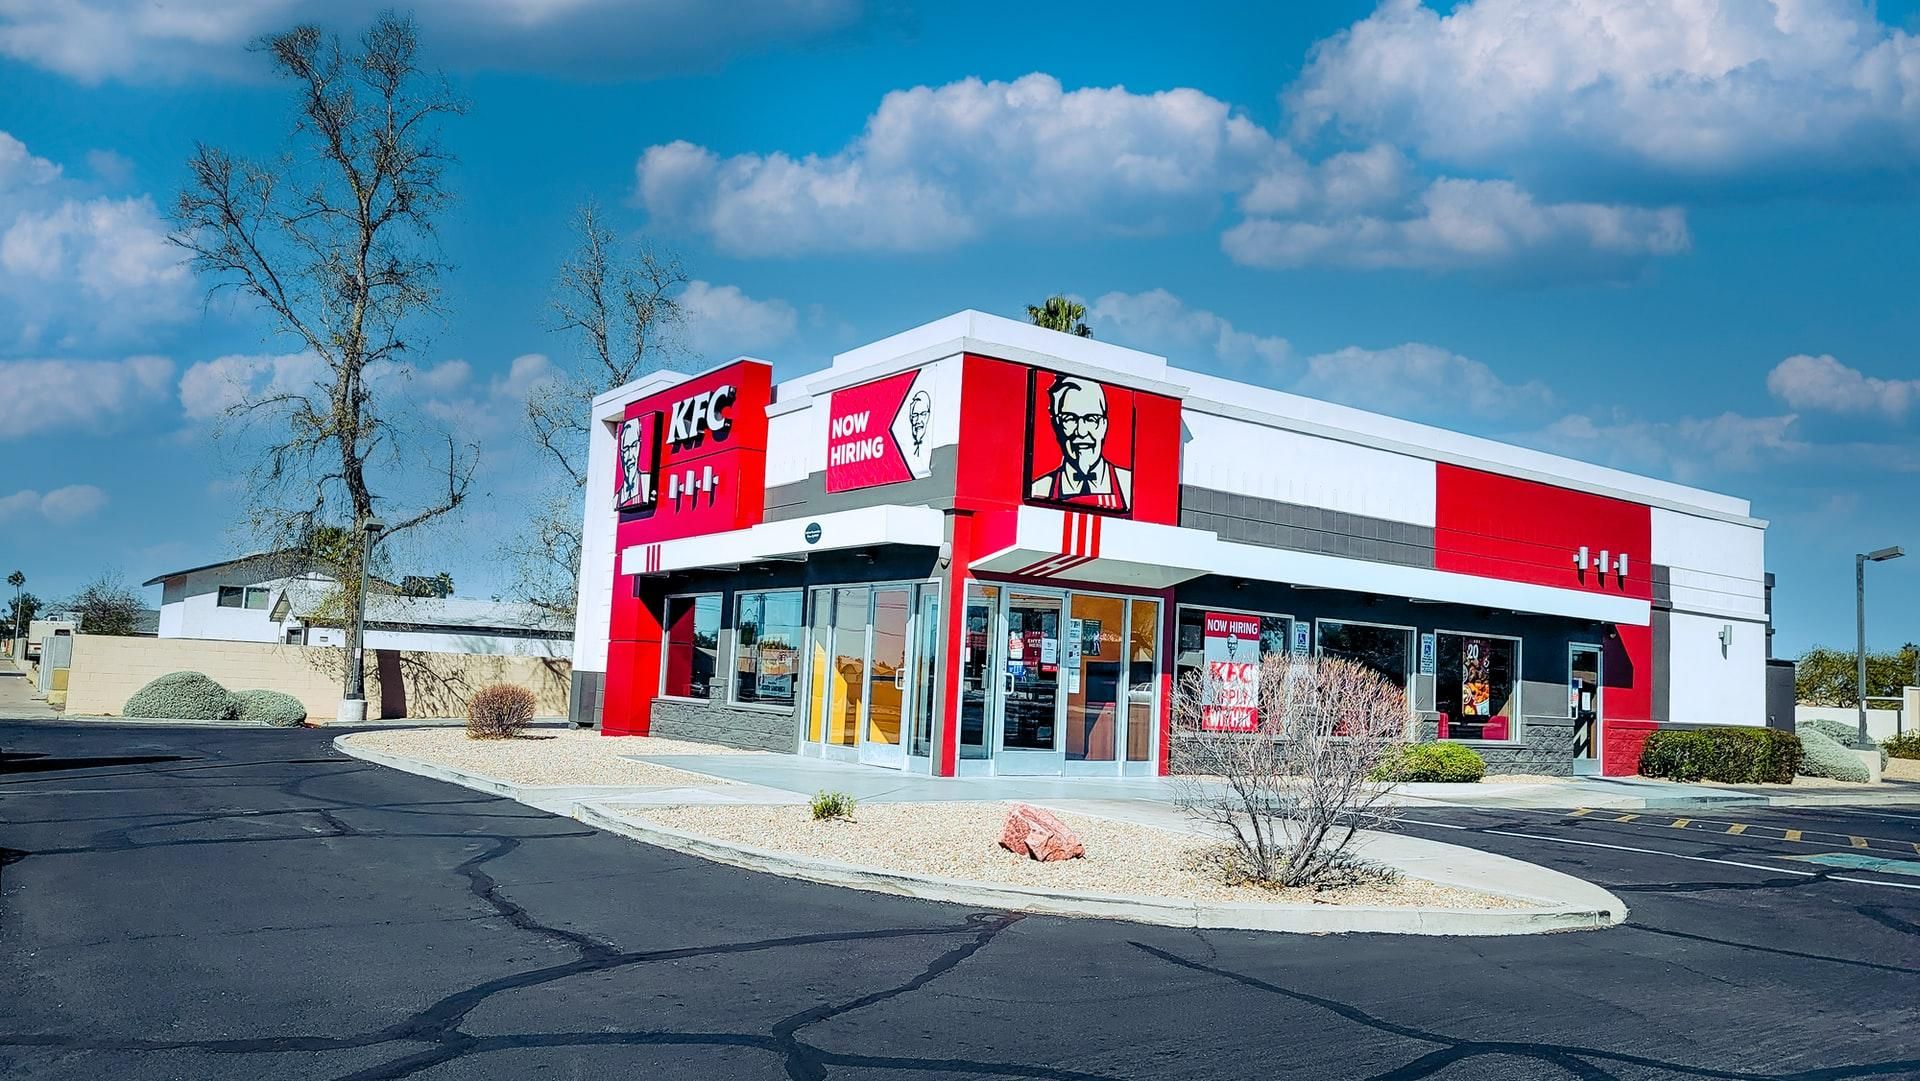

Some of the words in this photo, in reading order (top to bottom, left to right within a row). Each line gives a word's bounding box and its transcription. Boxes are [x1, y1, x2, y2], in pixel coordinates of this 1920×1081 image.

[666, 385, 730, 444] KFC
[832, 411, 870, 439] NOW
[831, 436, 884, 467] HIRING
[1207, 619, 1227, 632] NOW
[1229, 620, 1258, 634] HIRING
[1210, 661, 1254, 684] KFC
